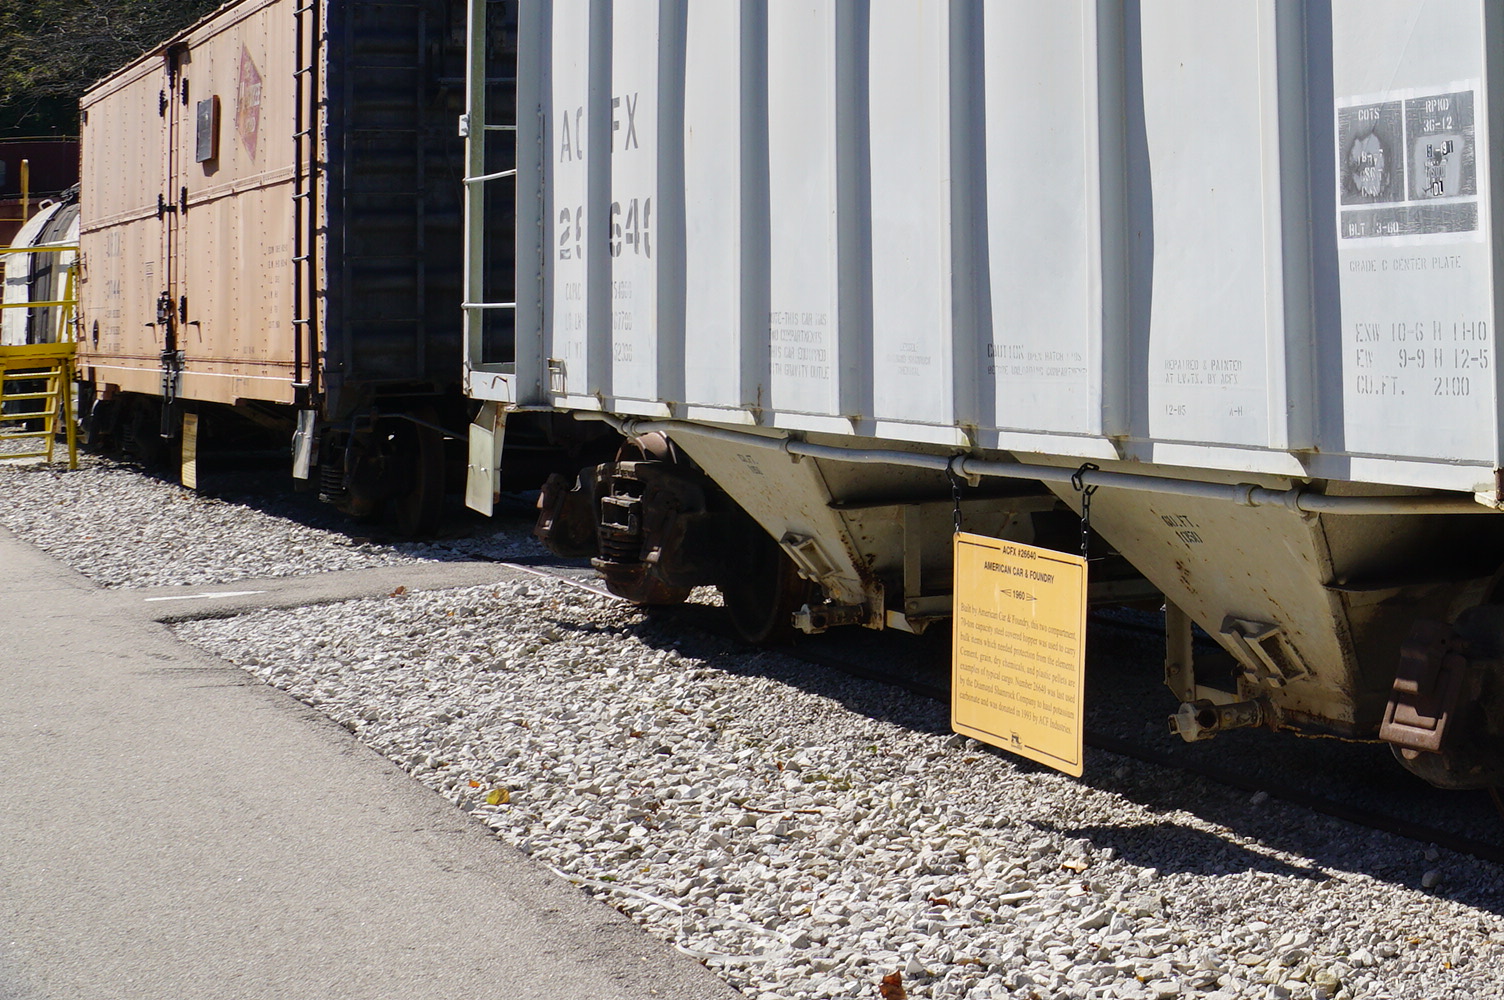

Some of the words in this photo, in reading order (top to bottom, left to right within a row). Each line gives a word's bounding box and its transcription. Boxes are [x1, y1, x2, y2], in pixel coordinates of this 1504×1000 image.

[1358, 107, 1380, 121] COTS
[1348, 222, 1366, 237] BLT
[1349, 260, 1377, 272] GRADE
[1393, 257, 1427, 271] CENTER
[1432, 255, 1461, 269] PLATE
[1164, 359, 1199, 371] REPAIRED
[1210, 359, 1242, 371] PAINTED
[1398, 348, 1425, 369] 9-9
[1454, 347, 1488, 369] 12-5
[1207, 373, 1217, 385] BY
[1433, 376, 1470, 396] 2100
[1002, 545, 1017, 557] ACFX
[984, 561, 1012, 576] AMERICAN
[1012, 566, 1025, 578] CAR
[1029, 570, 1055, 585] FOUNDRY
[1012, 589, 1027, 601] 1960
[978, 607, 998, 621] American
[1038, 714, 1049, 727] ACF
